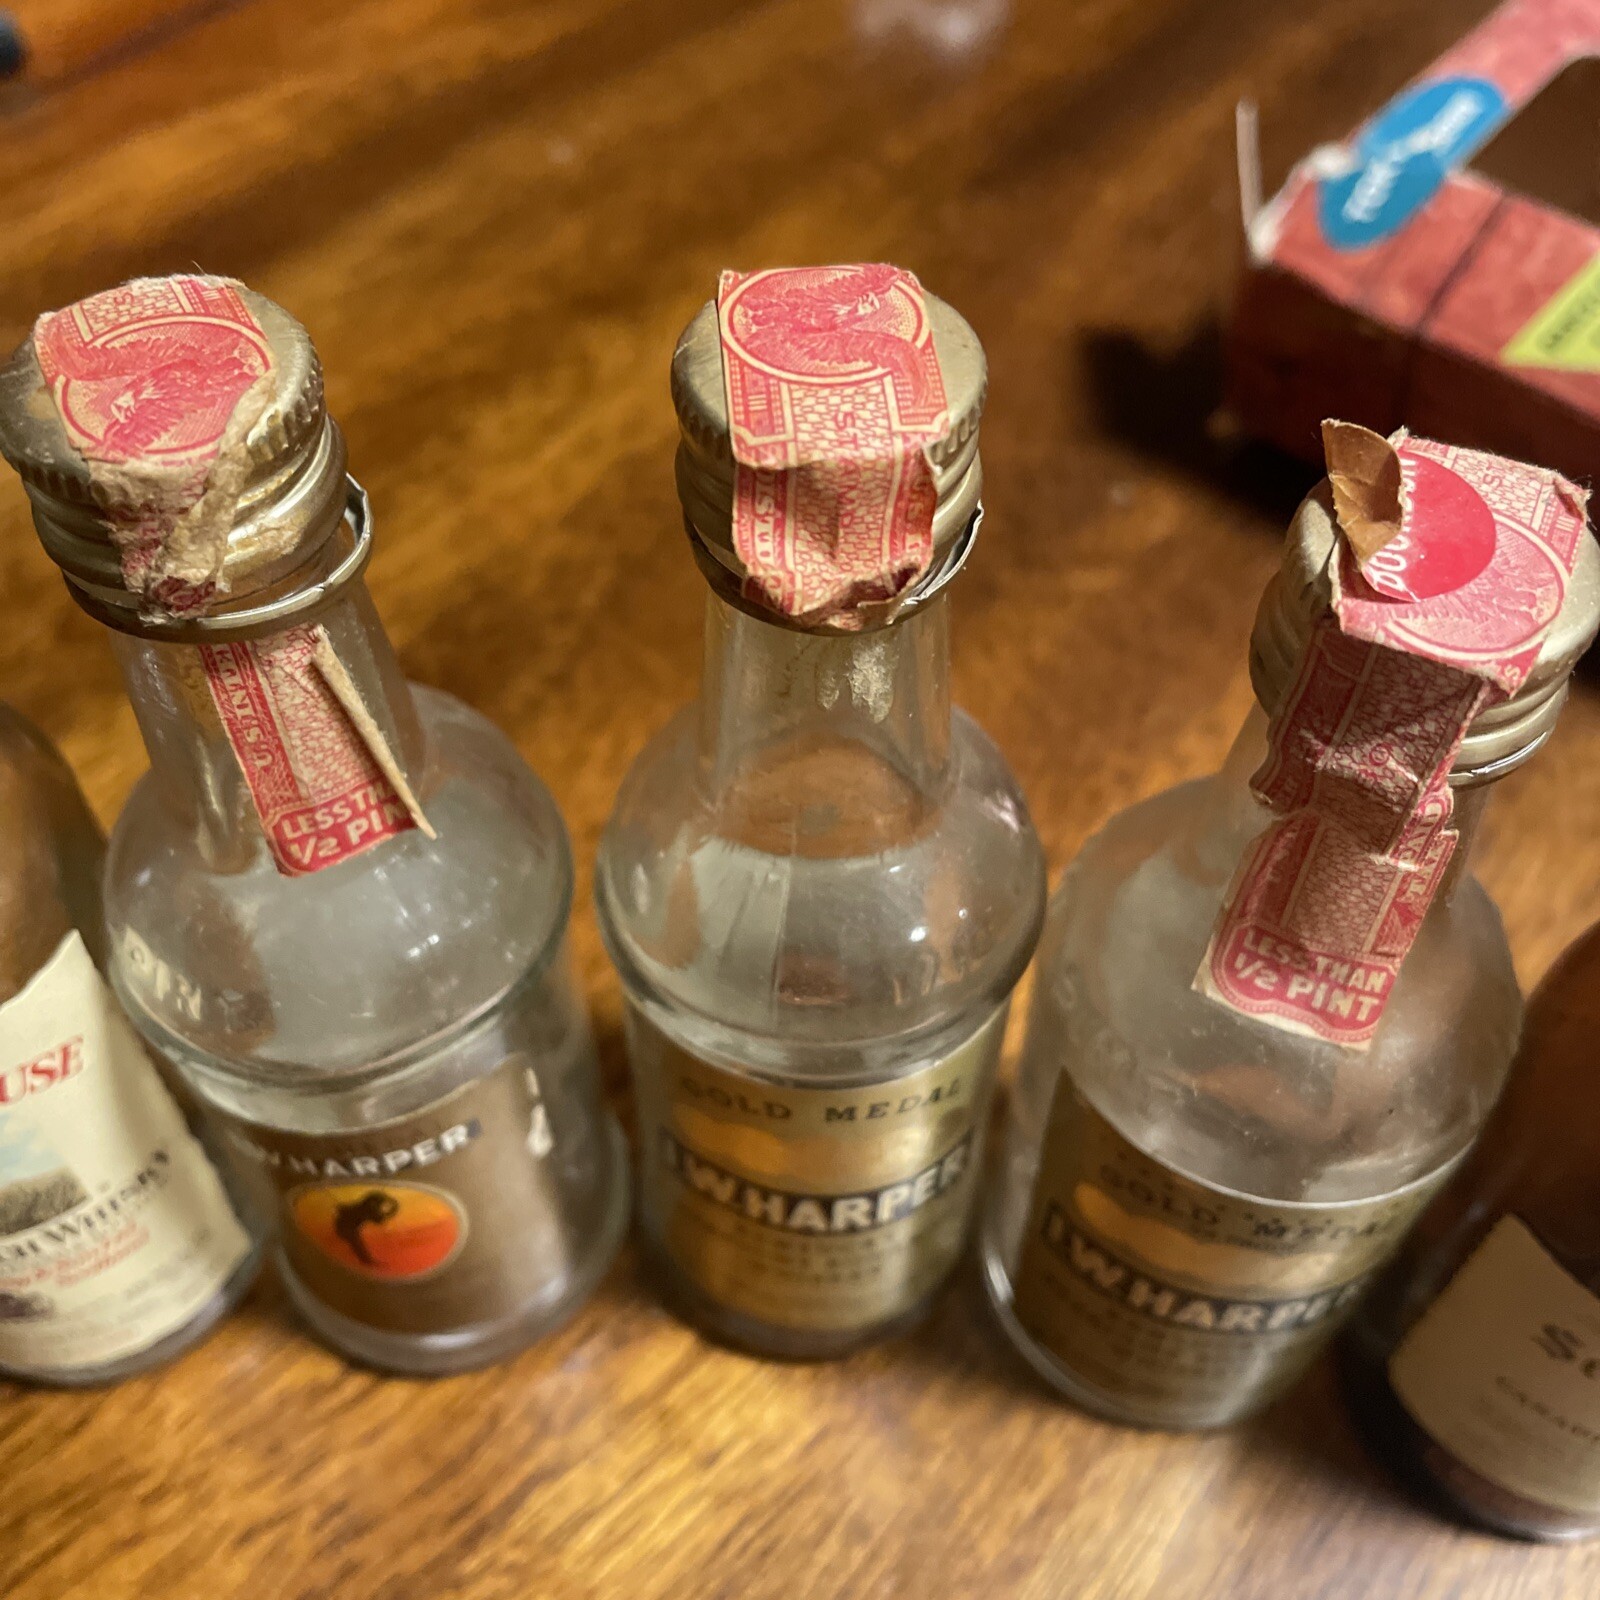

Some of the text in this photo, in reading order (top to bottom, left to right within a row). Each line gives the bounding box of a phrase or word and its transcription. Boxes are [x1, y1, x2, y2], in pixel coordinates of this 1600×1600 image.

[280, 800, 353, 841] LESS
[346, 802, 409, 846] PIN
[1243, 928, 1389, 994] LESS THAN
[1286, 973, 1382, 1023] PINT
[679, 1074, 963, 1124] GOLD MEDAL
